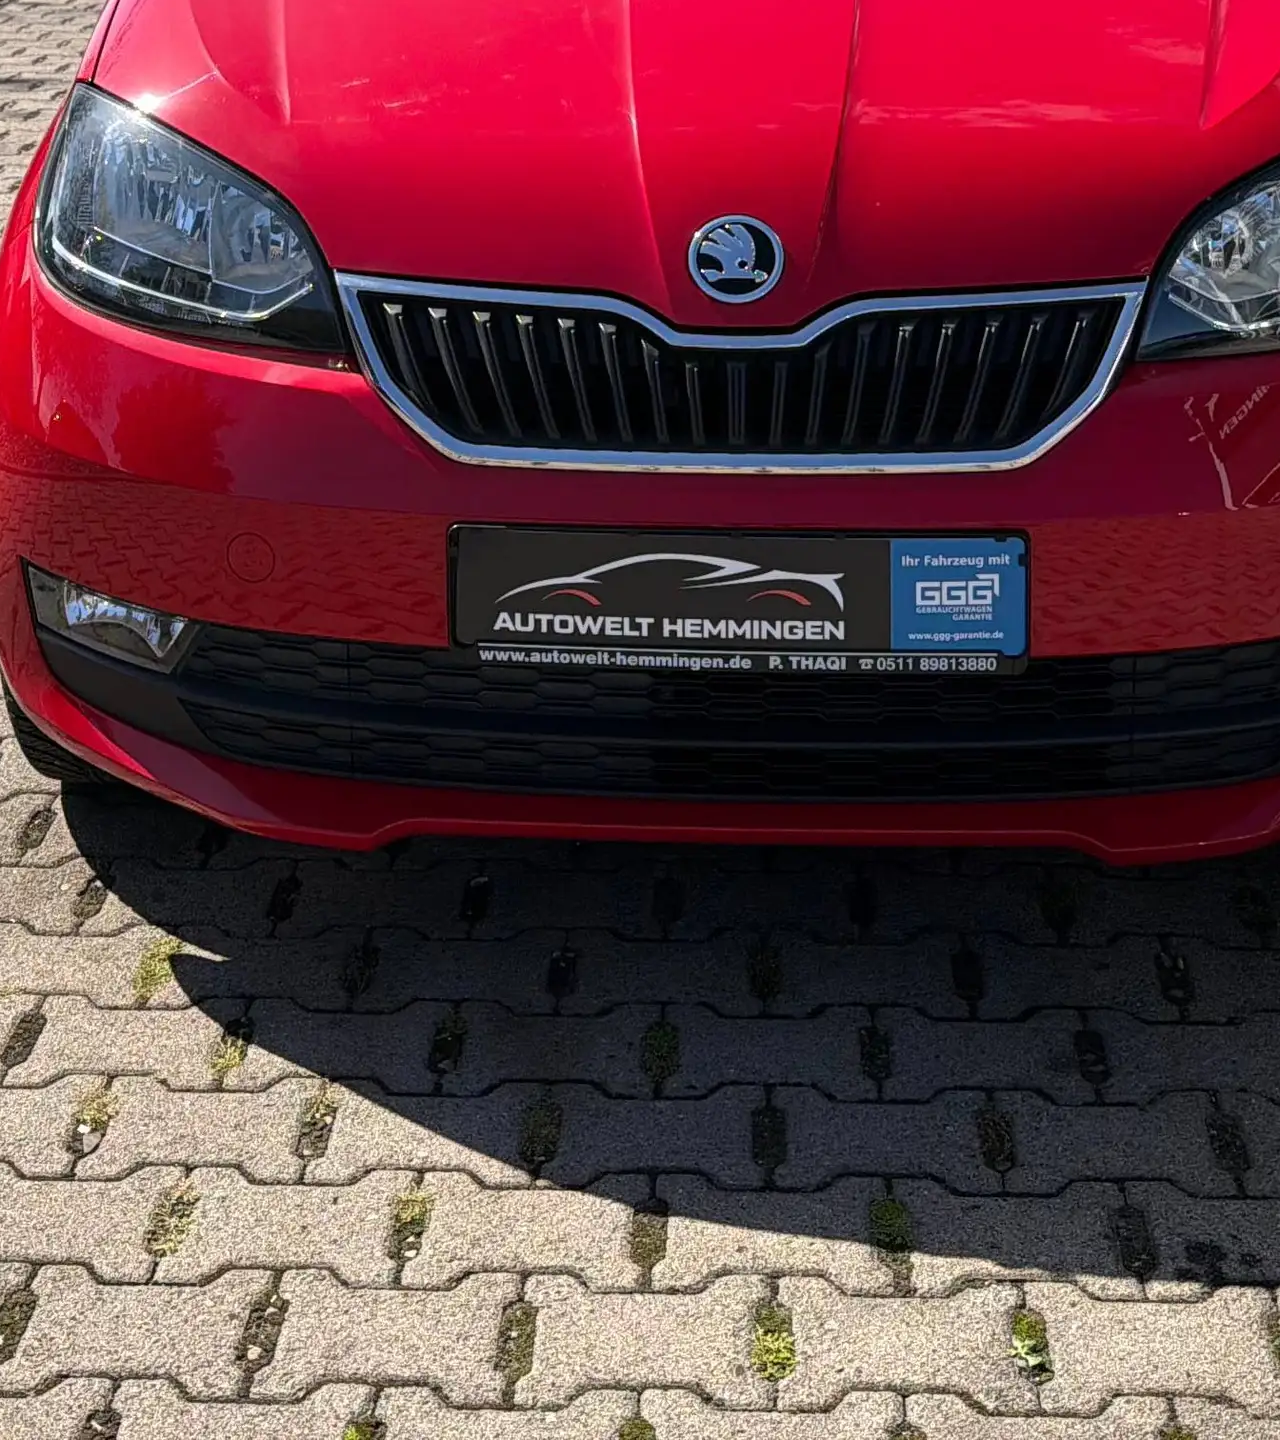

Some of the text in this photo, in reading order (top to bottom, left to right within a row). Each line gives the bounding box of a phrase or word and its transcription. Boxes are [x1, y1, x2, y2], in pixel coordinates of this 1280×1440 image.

[901, 553, 1011, 569] Ihr Fahrzeug mit
[914, 580, 994, 607] GGG
[914, 606, 994, 615] GEBRAUCHTWAGEN
[951, 613, 994, 622] GARANTIE
[492, 610, 846, 641] AUTOWELT HEMMINGEN
[907, 630, 1005, 642] www.ggg-garantie.de
[478, 647, 997, 673] www.autowelt-hemmingen.de P. THAQI 0511 89813880
